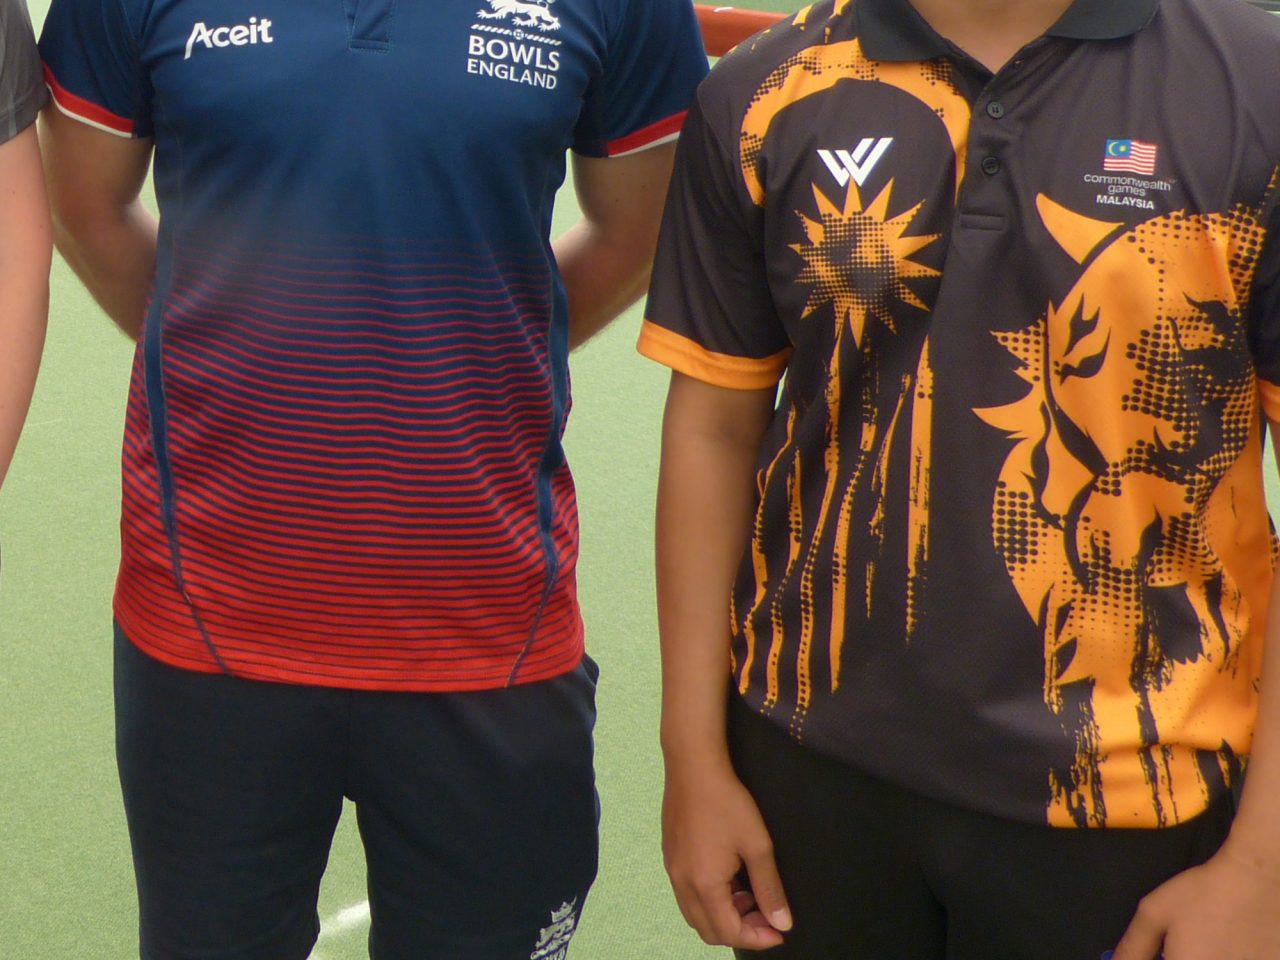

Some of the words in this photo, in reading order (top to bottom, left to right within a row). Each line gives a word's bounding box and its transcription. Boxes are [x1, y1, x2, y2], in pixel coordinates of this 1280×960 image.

[184, 16, 273, 60] Aceit
[468, 34, 560, 72] BOWLS
[467, 58, 557, 90] ENGLAND
[1083, 174, 1171, 191] commonwealth
[1107, 184, 1147, 197] games
[1096, 194, 1155, 210] MALAYSIA
